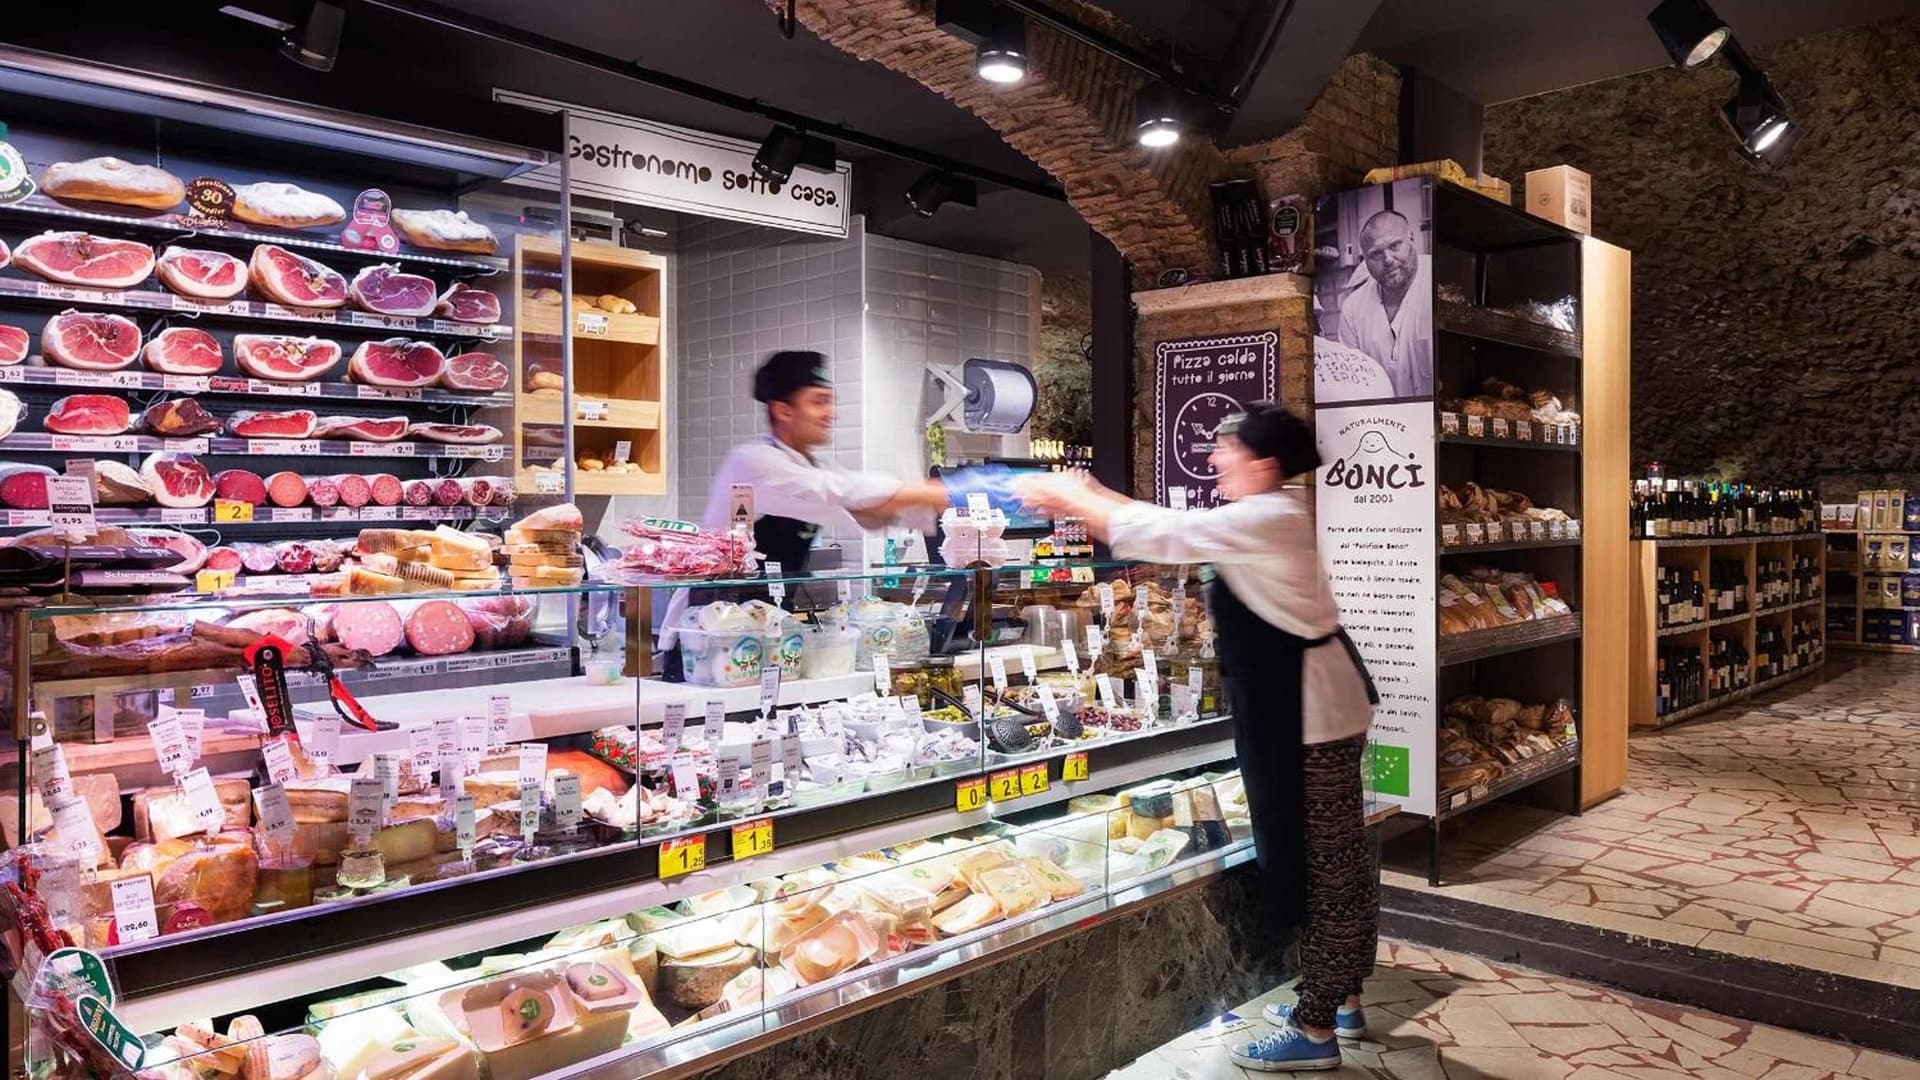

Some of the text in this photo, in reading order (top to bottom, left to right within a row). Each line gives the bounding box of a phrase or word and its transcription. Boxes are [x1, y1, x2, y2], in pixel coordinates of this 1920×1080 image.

[569, 134, 839, 208] Gastronomo sotto casa.
[1173, 347, 1257, 369] Pizza calda
[1172, 369, 1256, 386] tutto il giorno
[1339, 417, 1407, 436] NATURALMENTE
[1353, 494, 1394, 504] dal 2003
[261, 667, 286, 730] JOSELITO
